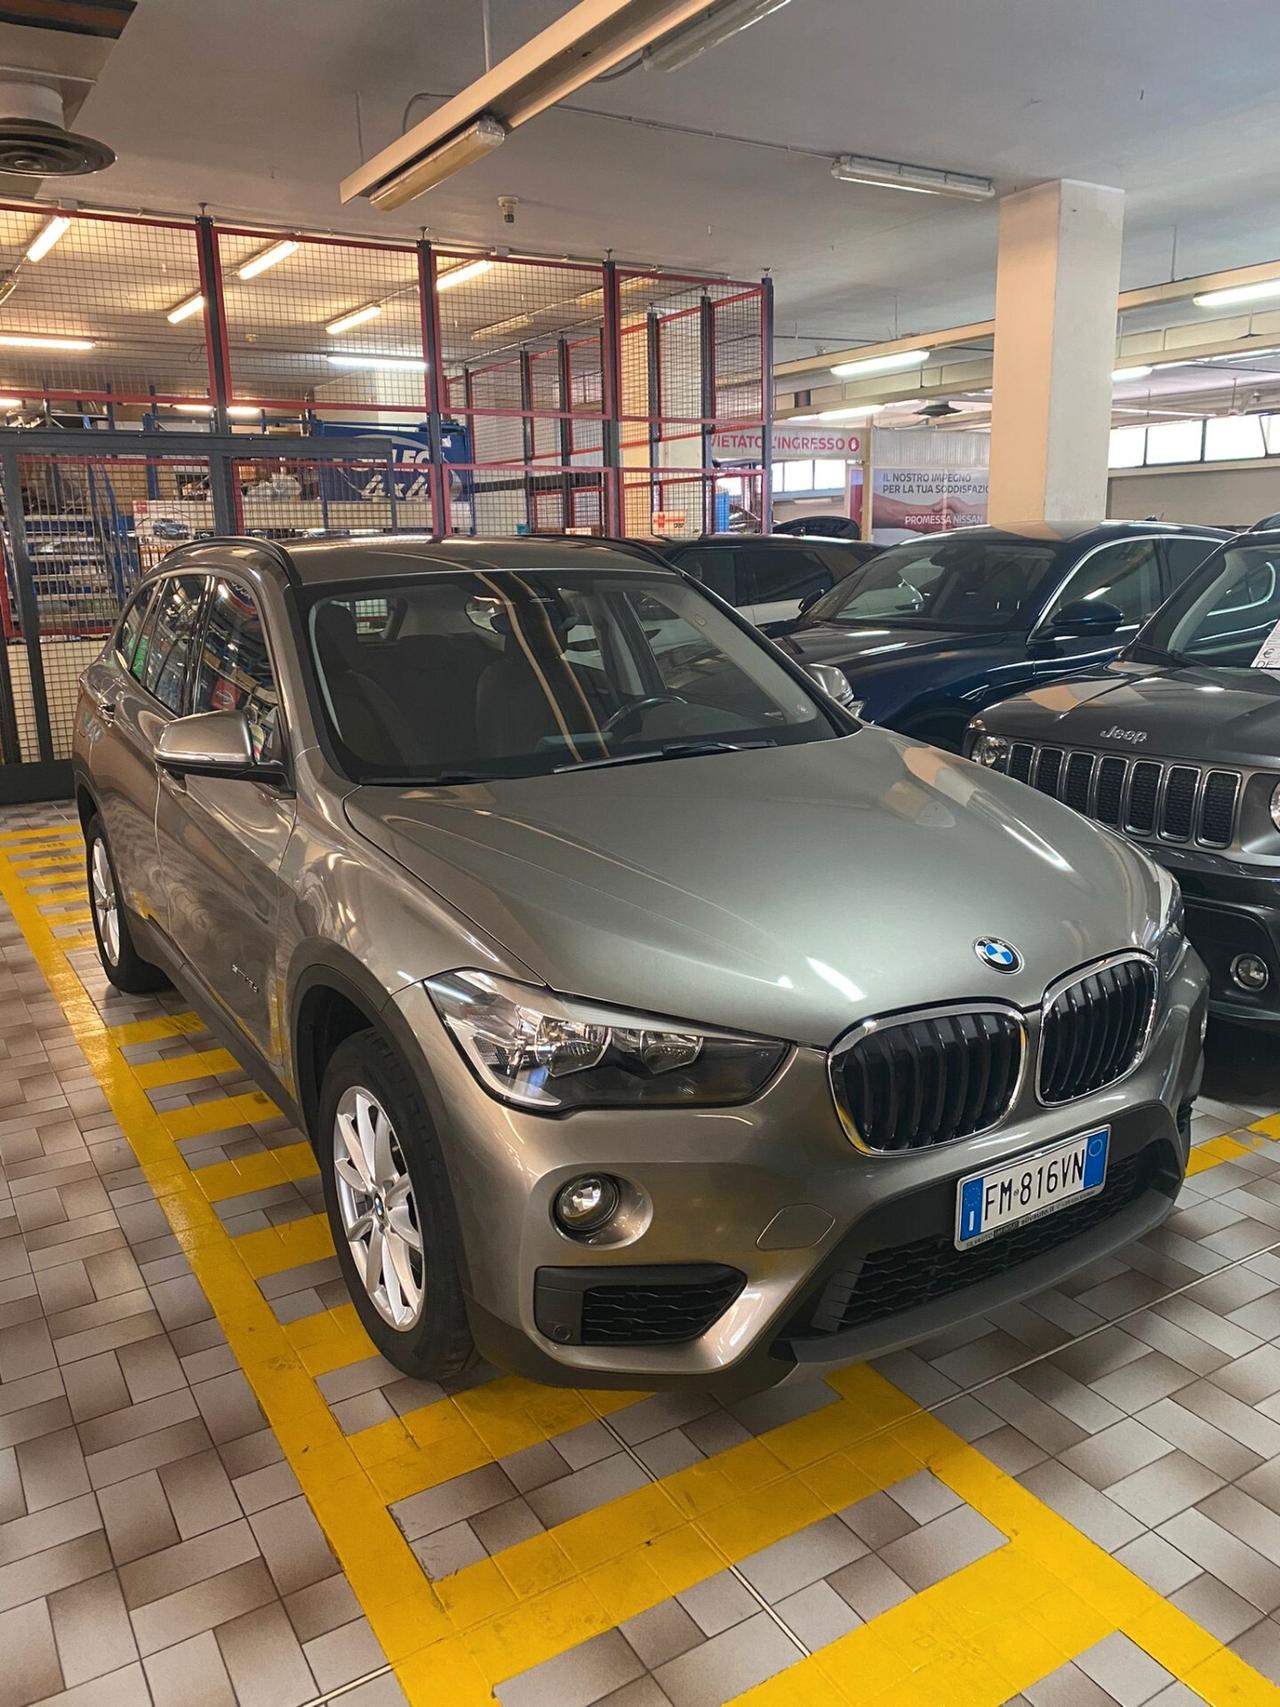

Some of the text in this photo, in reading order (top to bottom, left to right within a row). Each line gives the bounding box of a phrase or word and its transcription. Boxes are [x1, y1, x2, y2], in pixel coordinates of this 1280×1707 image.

[772, 436, 846, 450] 'INGRESSO
[883, 473, 972, 483] IL NOSTRO IMPEGNO
[882, 485, 901, 494] PER
[902, 485, 914, 494] LA
[916, 485, 933, 494] TUA
[904, 515, 983, 525] PROMESSA NISSAN
[1099, 724, 1148, 745] Jeep
